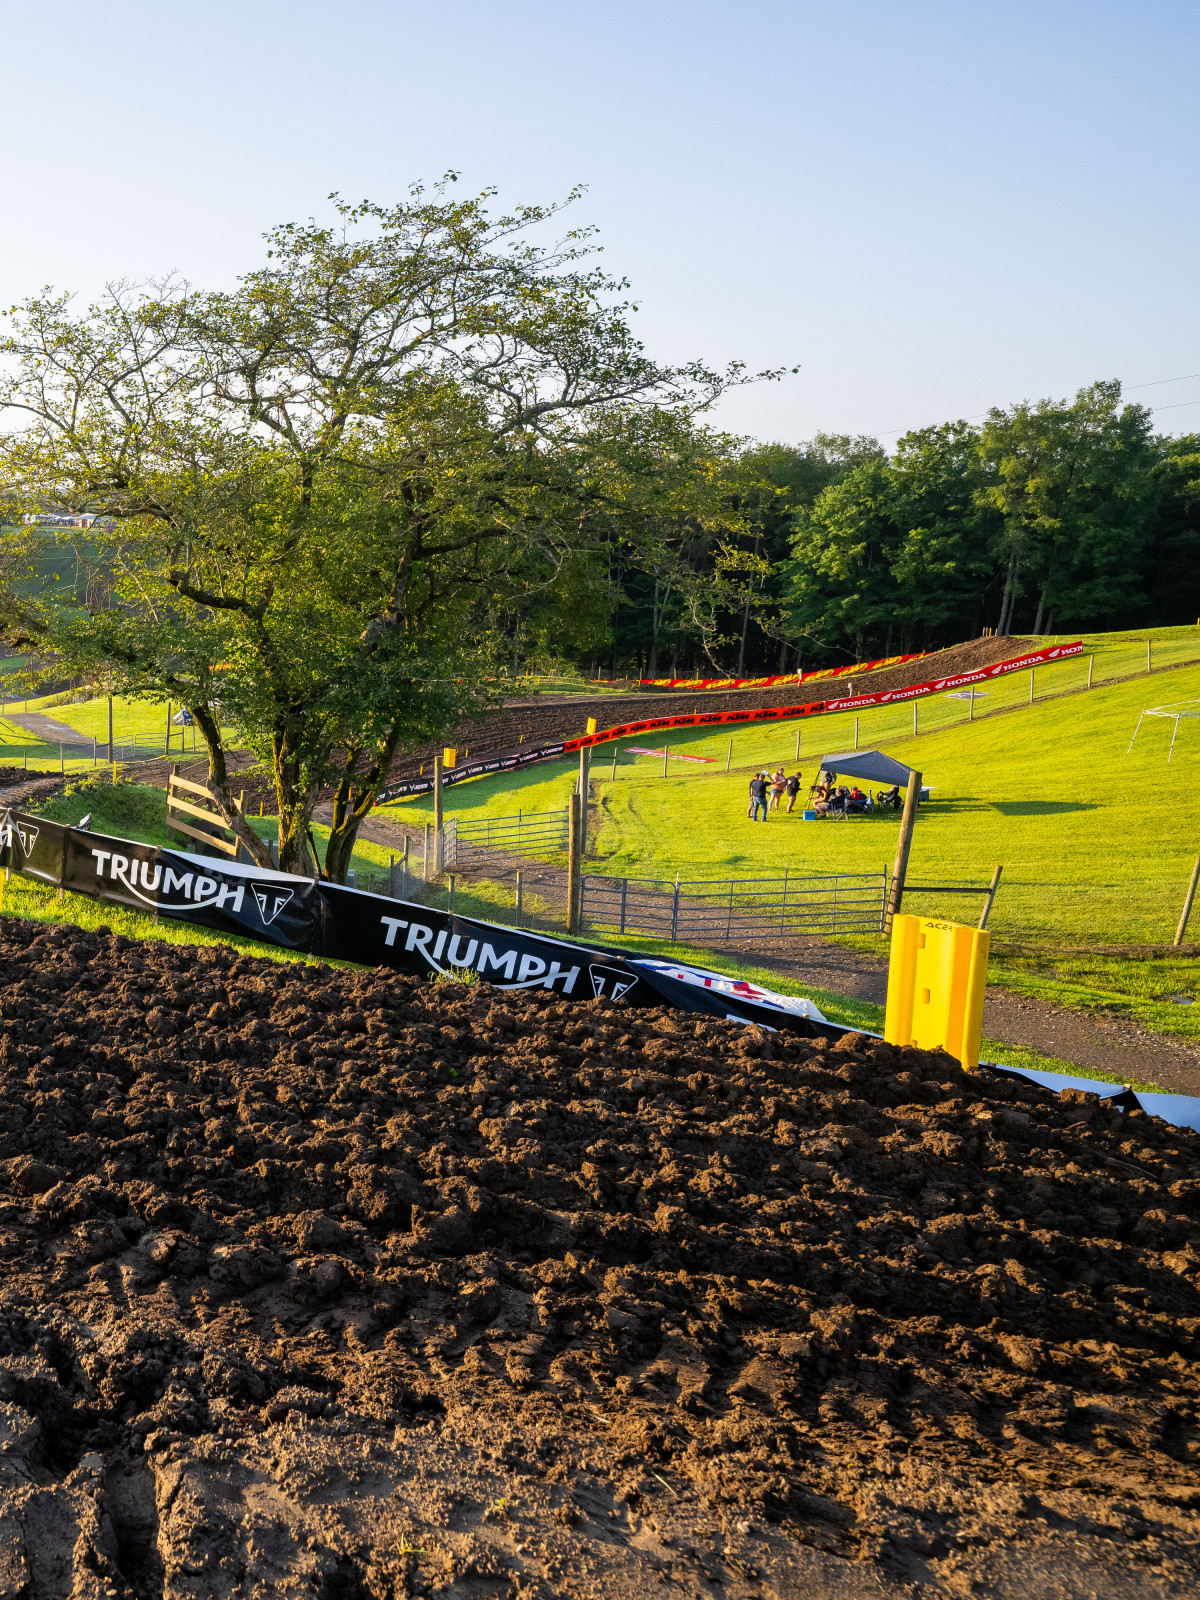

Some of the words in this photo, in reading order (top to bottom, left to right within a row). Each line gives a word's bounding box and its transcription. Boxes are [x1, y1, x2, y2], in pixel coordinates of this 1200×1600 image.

[839, 698, 877, 709] HONDA
[892, 687, 931, 700] HONDA
[946, 673, 987, 687] HONDA
[1003, 655, 1044, 671] HONDA
[612, 727, 627, 736] KTM
[630, 723, 647, 732] KTM
[650, 719, 670, 728] KTM
[674, 717, 695, 725] KTM
[700, 715, 722, 723] KTM
[754, 710, 778, 718] KTM
[783, 708, 806, 716] KTM
[91, 849, 246, 913] TRIUMPH
[380, 916, 583, 994] TRIUMPH
